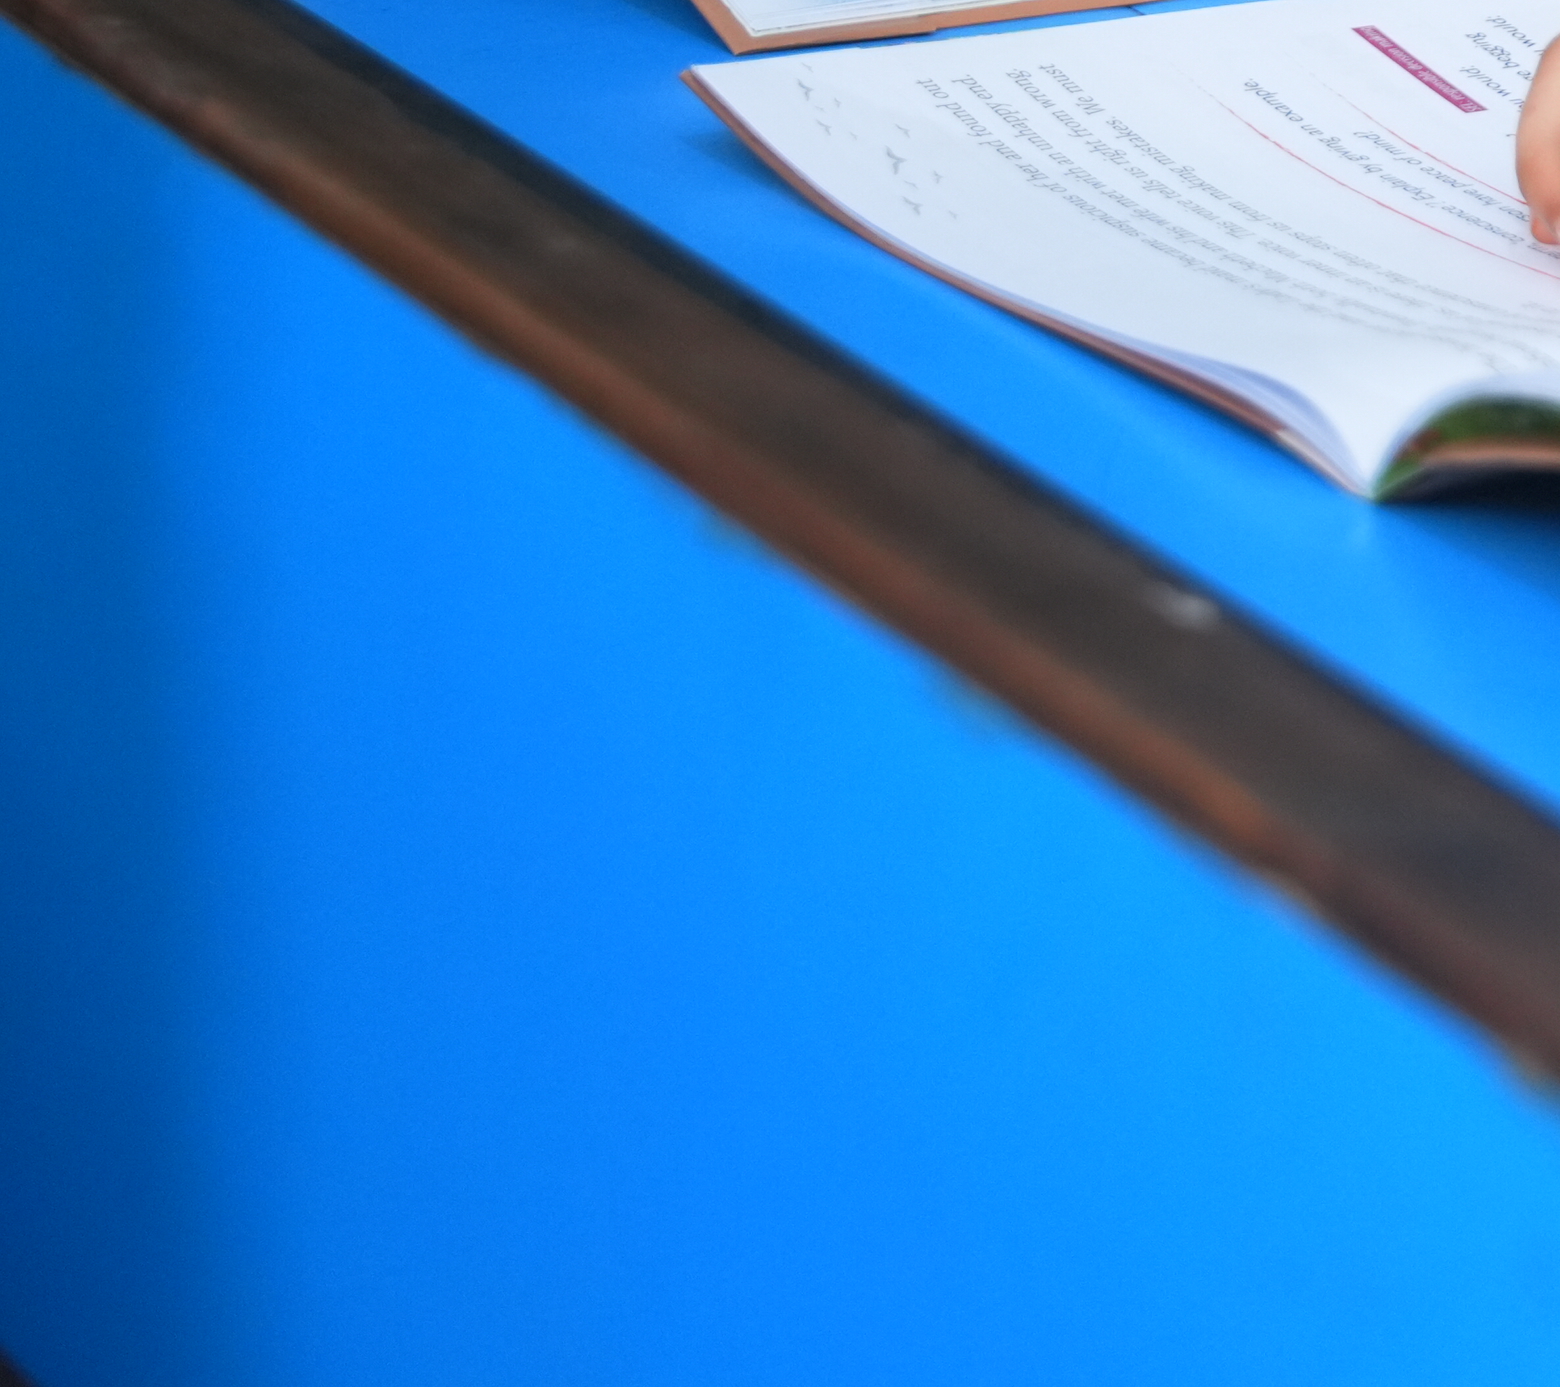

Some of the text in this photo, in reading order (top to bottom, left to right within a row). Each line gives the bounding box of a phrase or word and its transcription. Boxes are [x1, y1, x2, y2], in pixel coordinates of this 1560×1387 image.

[1465, 32, 1520, 69] begging
[914, 77, 951, 99] out
[948, 73, 996, 101] end.
[1002, 67, 1061, 109] wrong.
[1036, 63, 1084, 93] must
[1071, 95, 1107, 115] We
[1236, 78, 1308, 123] example.
[934, 101, 994, 137] found
[980, 101, 1059, 151] unhappy
[1045, 109, 1095, 139] from
[978, 139, 1024, 161] and
[1080, 138, 1134, 165] right
[1098, 116, 1180, 165] mistakes.
[1314, 136, 1372, 161] giving
[1350, 130, 1408, 155] mind?
[1061, 167, 1110, 189] with
[1138, 179, 1182, 199] tells
[1164, 165, 1236, 201] making
[1373, 173, 1440, 201] Explain
[1416, 166, 1474, 189] peace
[1059, 193, 1148, 237] suspicious
[1173, 199, 1222, 221] voice
[1224, 200, 1272, 222] from
[1286, 231, 1341, 251] stops
